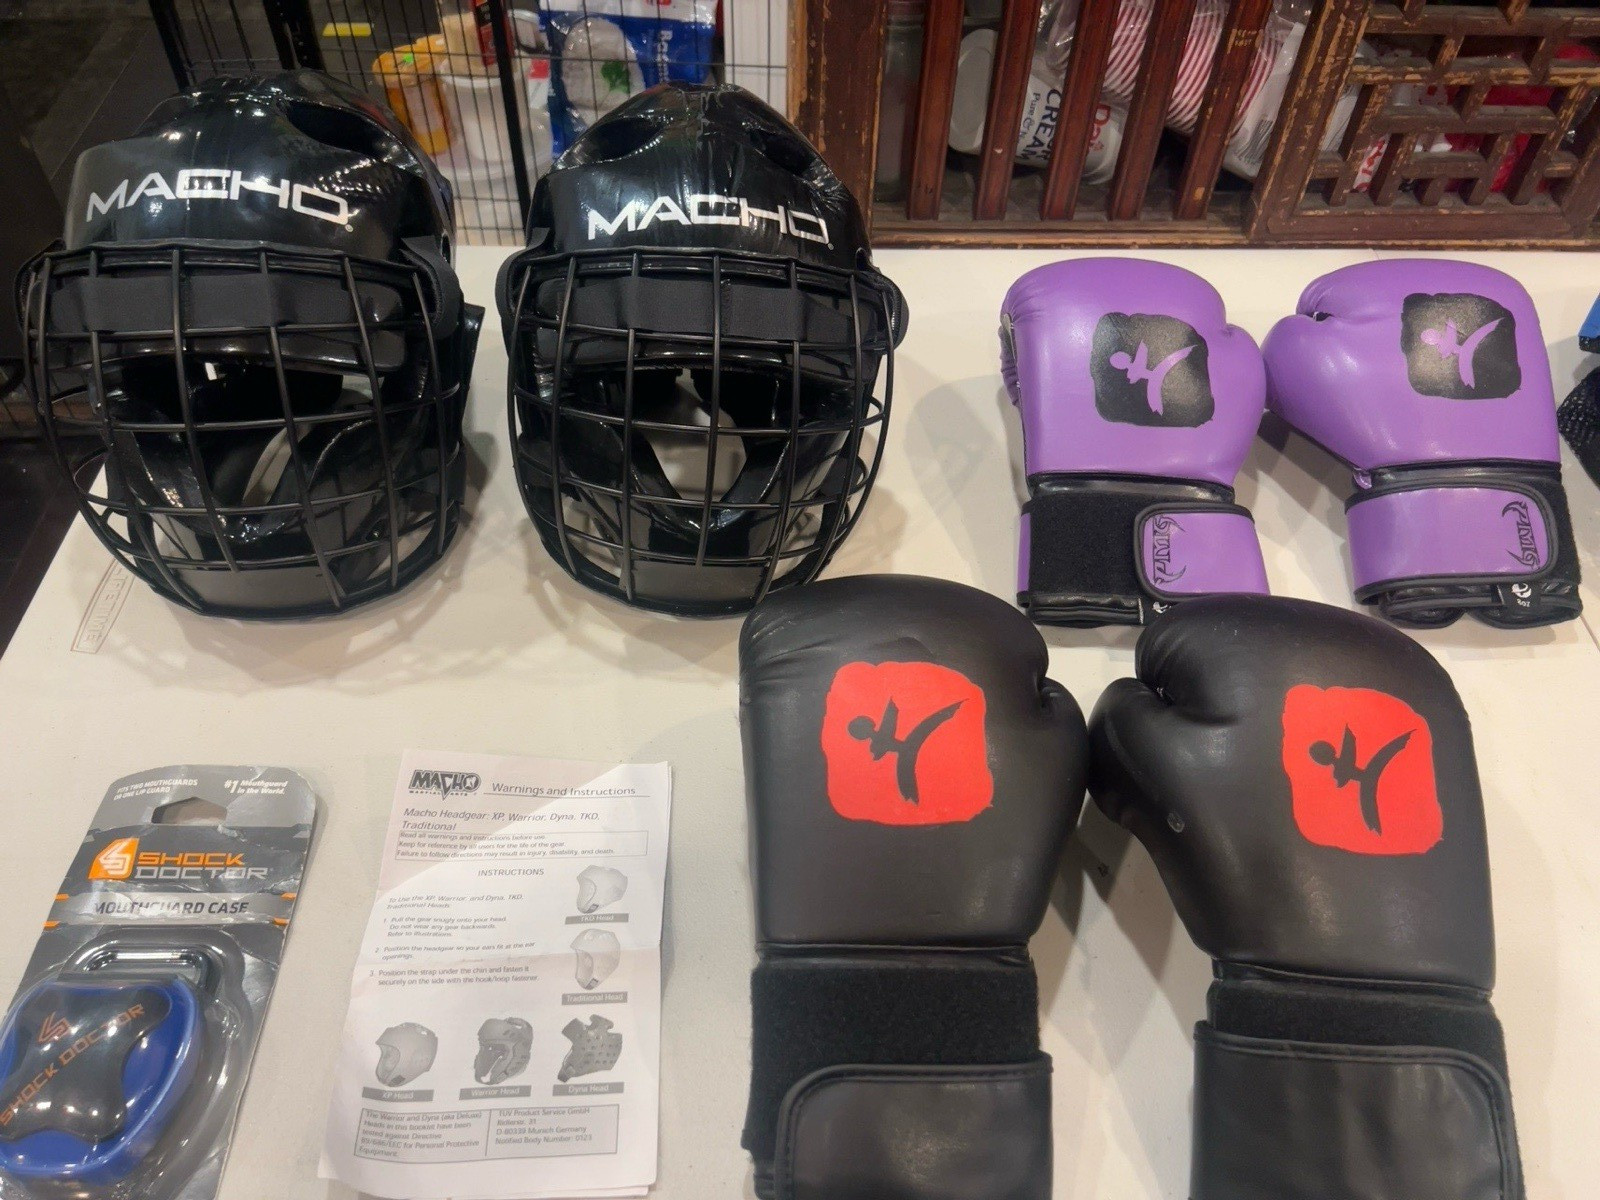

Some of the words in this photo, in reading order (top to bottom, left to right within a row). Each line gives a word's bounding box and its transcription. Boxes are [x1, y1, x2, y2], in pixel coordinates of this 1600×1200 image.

[1020, 88, 1062, 160] CREAM
[85, 168, 349, 226] MACHO
[588, 194, 830, 244] MACHO
[144, 778, 198, 788] MOUTHGUARDS
[224, 780, 239, 794] #1
[240, 780, 288, 788] Mouthguard
[408, 770, 482, 801] MACHO
[492, 782, 544, 796] Warnings
[546, 787, 568, 796] and
[570, 788, 636, 796] Instructions
[146, 786, 170, 794] GUARD
[404, 808, 438, 818] Macho
[440, 809, 490, 821] Headgear:
[402, 820, 457, 831] Traditional
[138, 852, 246, 866] SHOCK
[134, 866, 269, 880] DOCTOR
[478, 868, 545, 878] INSTRUCTIONS
[208, 902, 250, 914] CASE
[475, 975, 510, 983] hook/loop
[567, 994, 604, 1002] Traditional
[605, 992, 625, 1001] Head
[0, 1062, 58, 1126] SHOCK
[471, 1087, 498, 1096] Warrior
[500, 1087, 520, 1095] Head
[568, 1085, 588, 1094] Dyna
[590, 1084, 610, 1092] Head
[542, 1108, 566, 1116] Service
[567, 1107, 590, 1115] GmbH
[380, 1112, 405, 1121] Warrior
[421, 1114, 440, 1122] Dyna
[364, 1120, 386, 1128] Heads
[362, 1129, 384, 1137] tested
[555, 1125, 587, 1134] Germany
[495, 1136, 522, 1145] Notified
[524, 1136, 541, 1145] Body
